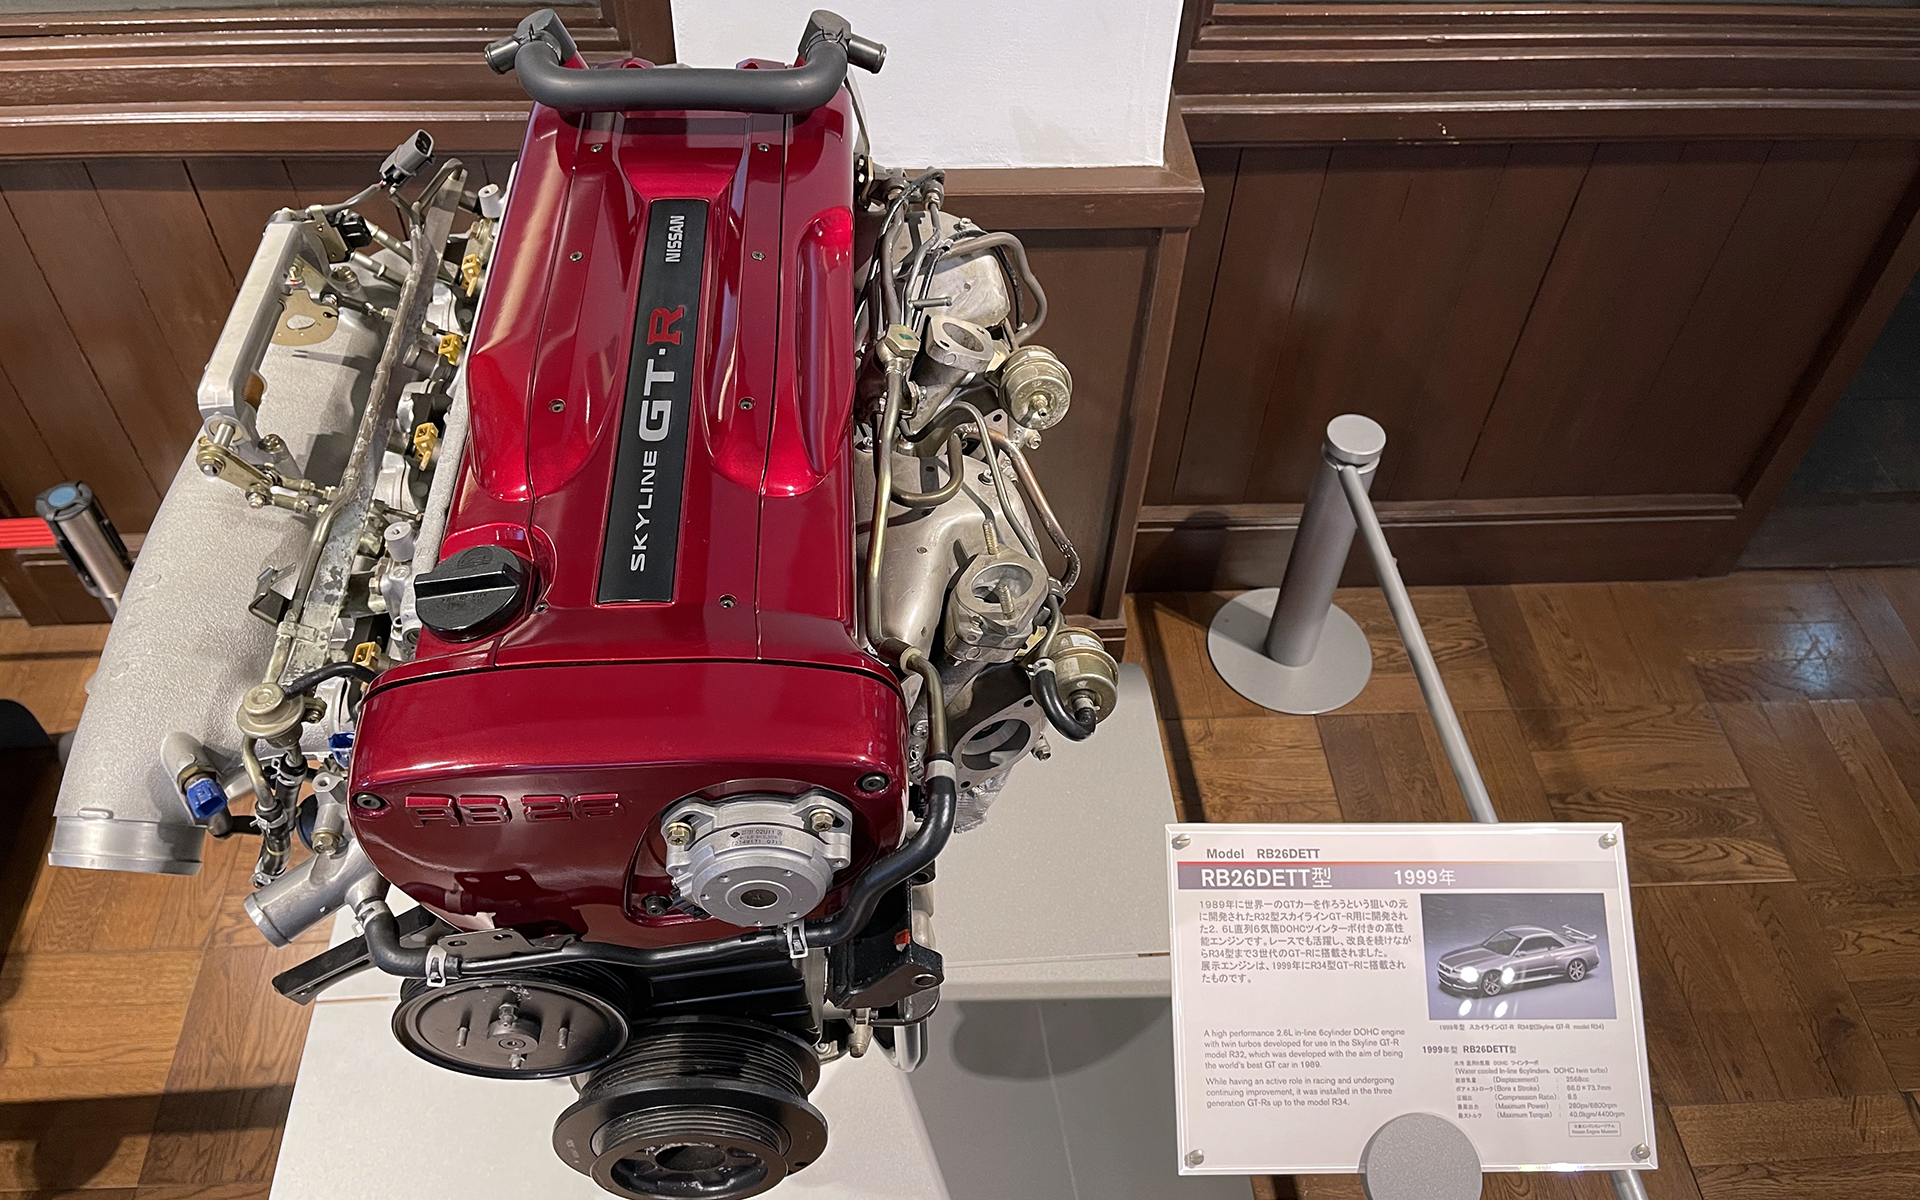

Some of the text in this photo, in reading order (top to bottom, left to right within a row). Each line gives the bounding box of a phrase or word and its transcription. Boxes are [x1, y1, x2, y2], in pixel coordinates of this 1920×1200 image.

[665, 214, 687, 263] NISSAN
[630, 449, 659, 573] SKYLINE
[1207, 848, 1320, 859] Model RB26DETT
[1201, 867, 1456, 888] RB26DETT型 1999年
[1199, 899, 1408, 910] 1989年に世界一のGTカーを作ろうという狙いの元
[1199, 911, 1408, 922] に開発されたR32型スカイラインGT-R用に開発され
[1200, 935, 1412, 947] 能エンジンです。レースでも活躍し、改良を続けなが
[1201, 947, 1388, 959] らR34型まで3世代のGT-Rに搭載されました。
[1201, 959, 1406, 971] 展示エンジンは、1999年にR34型GT-Rに搭載され
[1202, 973, 1251, 984] たものです。
[1204, 1027, 1405, 1040] A high performance 2.6L in-line 6cylinder DOHC engine
[1204, 1040, 1220, 1048] with
[1221, 1040, 1237, 1048] twin
[1238, 1040, 1262, 1048] turbos
[1263, 1039, 1301, 1049] developed
[1302, 1039, 1313, 1047] for
[1329, 1039, 1337, 1047] in
[1337, 1039, 1350, 1047] the
[1351, 1038, 1378, 1049] Skyline
[1379, 1038, 1399, 1047] GT-R
[1204, 1050, 1227, 1059] model
[1228, 1050, 1247, 1059] R32,
[1248, 1050, 1271, 1058] which
[1288, 1049, 1327, 1059] developed
[1327, 1049, 1344, 1057] with
[1345, 1049, 1357, 1057] the
[1358, 1049, 1372, 1057] aim
[1373, 1049, 1381, 1057] of
[1382, 1049, 1403, 1059] being
[1422, 1045, 1516, 1054] 1999年型 RB26DETT型
[1205, 1061, 1217, 1070] the
[1218, 1061, 1245, 1069] world's
[1246, 1061, 1263, 1069] best
[1264, 1060, 1276, 1069] GT
[1300, 1060, 1322, 1069] 1989.
[1477, 1067, 1498, 1075] cooled
[1589, 1066, 1608, 1074] turbo)
[1205, 1077, 1227, 1085] While
[1228, 1077, 1253, 1087] having
[1265, 1077, 1287, 1085] active
[1288, 1076, 1303, 1085] role
[1304, 1076, 1312, 1084] in
[1313, 1078, 1336, 1086] racing
[1337, 1076, 1352, 1084] and
[1353, 1076, 1395, 1086] undergoing
[1206, 1088, 1244, 1098] continuing
[1245, 1088, 1295, 1098] improvement,
[1296, 1087, 1301, 1095] it
[1319, 1087, 1350, 1096] installed
[1351, 1087, 1359, 1095] in
[1359, 1087, 1372, 1095] the
[1373, 1087, 1393, 1095] three
[1206, 1099, 1246, 1109] generation
[1247, 1098, 1271, 1107] GT-Rs
[1272, 1100, 1283, 1108] up
[1293, 1098, 1306, 1106] the
[1307, 1098, 1330, 1106] model
[1331, 1098, 1350, 1106] R34.
